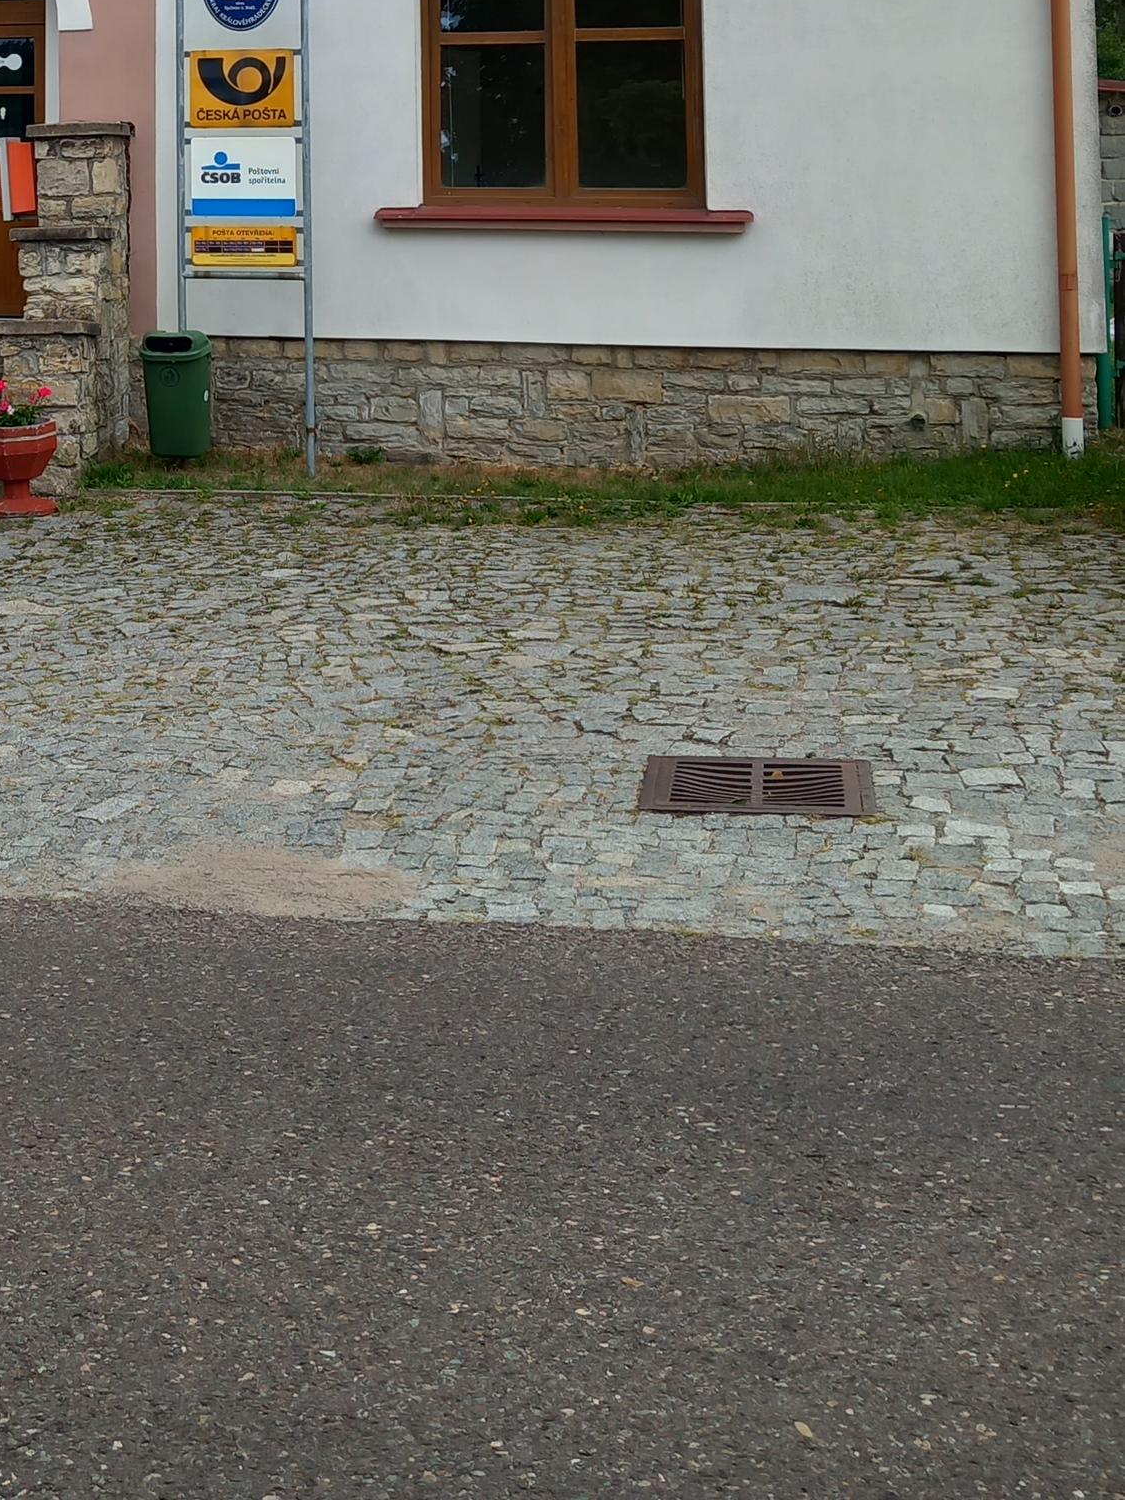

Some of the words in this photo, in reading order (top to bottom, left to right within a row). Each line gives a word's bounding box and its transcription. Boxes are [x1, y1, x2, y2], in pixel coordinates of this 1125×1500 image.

[196, 108, 240, 120] ČESKÁ
[243, 107, 287, 120] POŠTA
[201, 171, 241, 184] ČSOB
[248, 176, 286, 185] spořitelna
